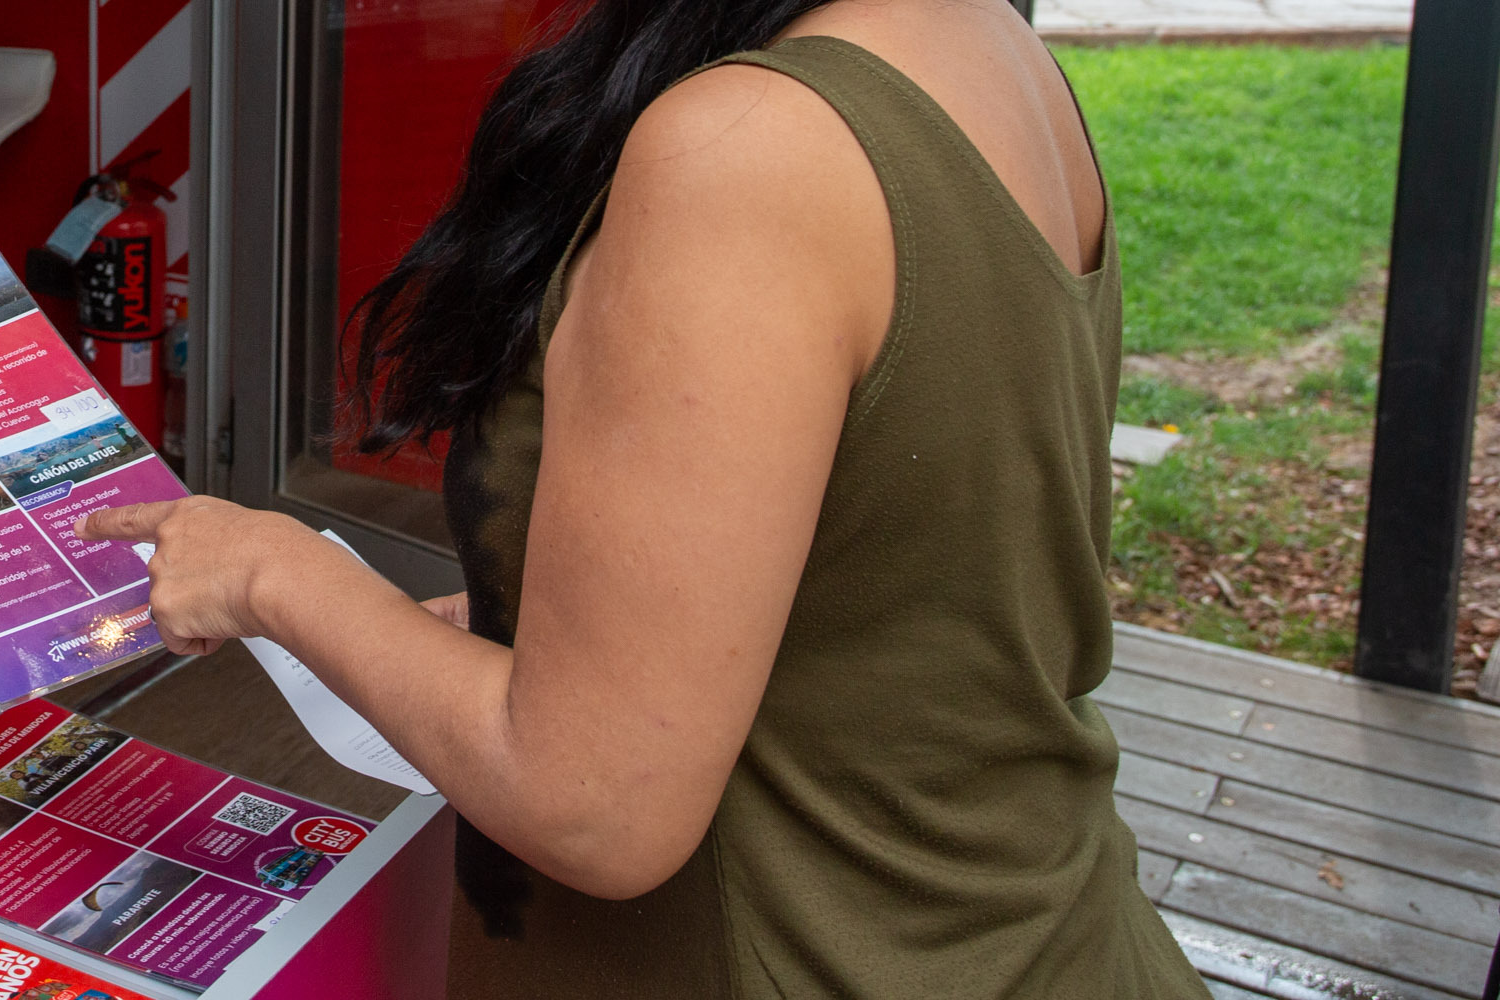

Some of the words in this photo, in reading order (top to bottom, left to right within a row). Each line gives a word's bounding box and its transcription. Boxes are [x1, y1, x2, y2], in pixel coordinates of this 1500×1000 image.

[117, 243, 149, 330] yukon
[2, 354, 37, 370] recorrido
[36, 349, 47, 357] de
[7, 395, 50, 415] Aconcagua
[1, 414, 30, 428] Cuevas
[30, 464, 70, 484] CAÑÓN
[67, 458, 89, 470] DEL
[88, 445, 120, 463] ATUEL
[43, 505, 72, 520] Ciudad
[81, 497, 97, 506] San
[95, 487, 120, 500] Rafael
[50, 520, 69, 529] Villa
[67, 515, 80, 524] 25
[10, 548, 22, 556] de
[67, 539, 84, 548] City
[71, 550, 88, 559] San
[86, 540, 112, 553] Rafael
[8, 735, 22, 744] DE
[17, 711, 53, 737] MENDOZA
[28, 754, 88, 795] VILLAVICENCIO
[84, 738, 108, 755] PARK
[303, 819, 335, 843] CITY
[321, 828, 351, 847] BUS
[112, 889, 161, 926] PARAPENTE
